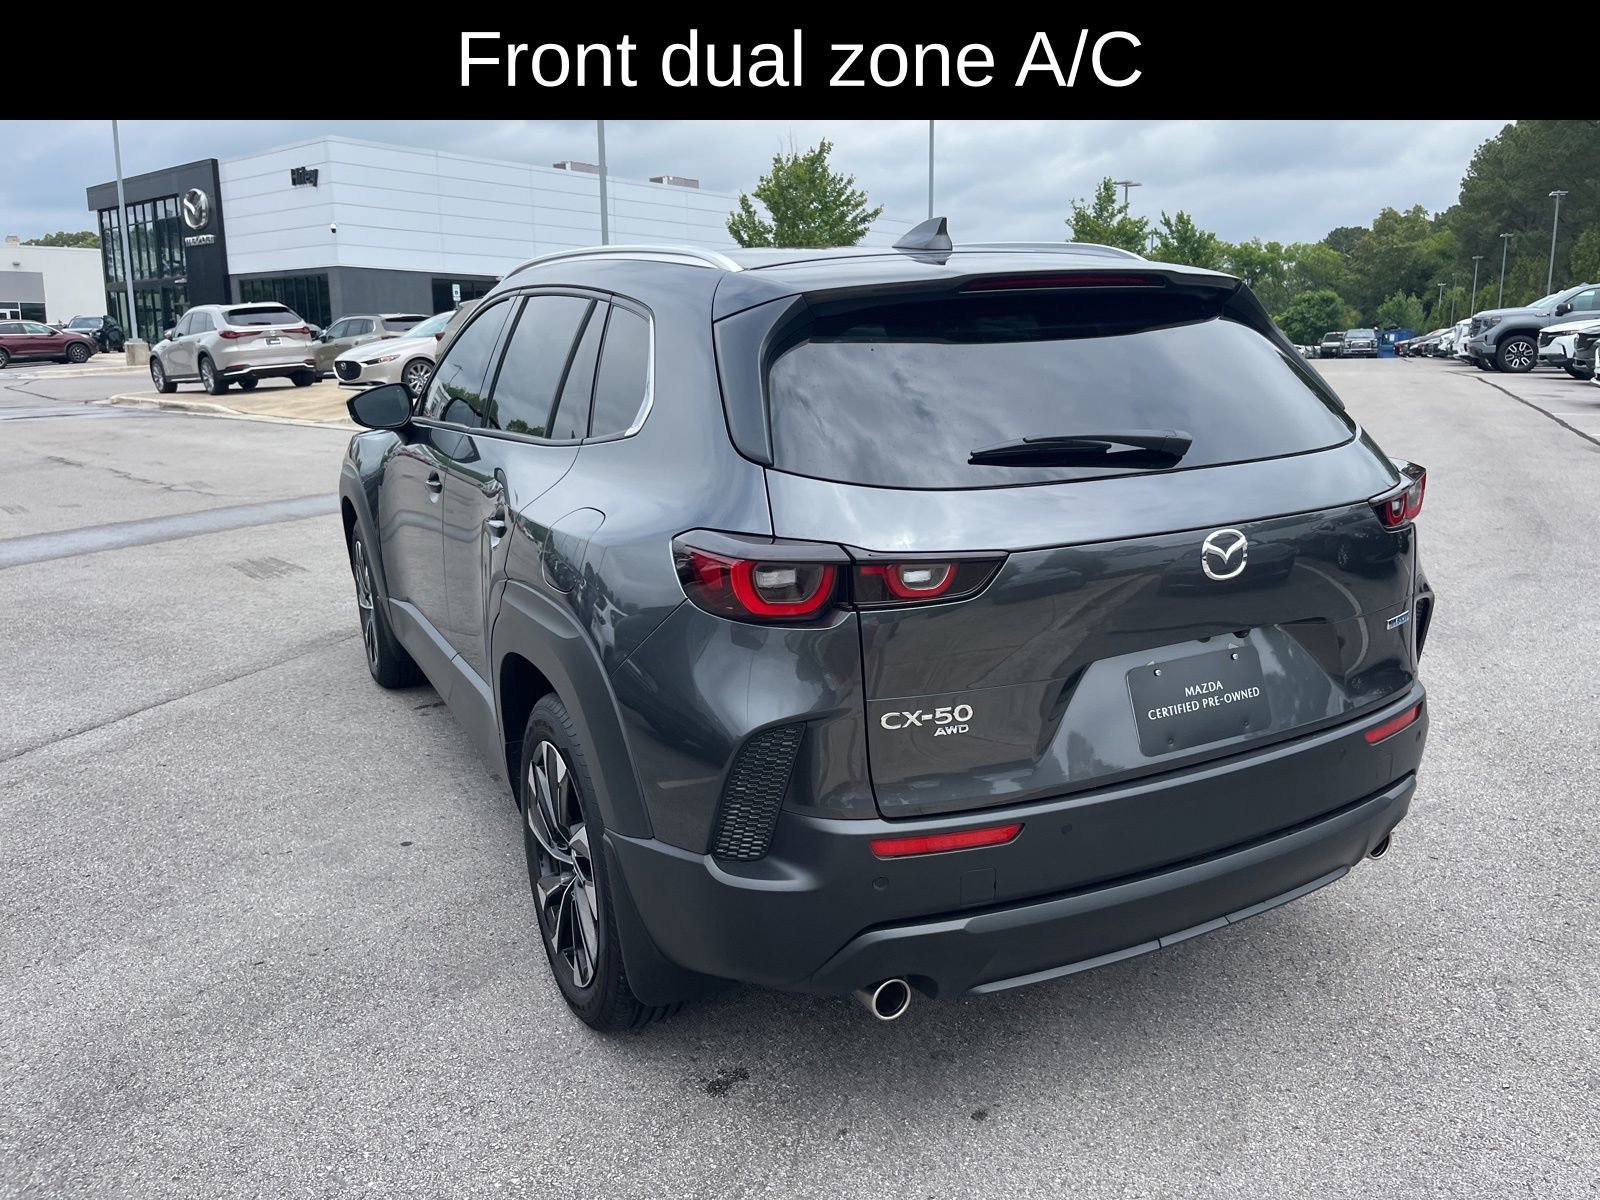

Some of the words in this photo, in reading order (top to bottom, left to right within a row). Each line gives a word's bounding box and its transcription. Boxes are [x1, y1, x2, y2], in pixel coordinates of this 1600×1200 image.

[1185, 680, 1224, 698] MAZDA
[1147, 700, 1200, 721] CERTIFIED
[1202, 686, 1260, 709] PRE-OWNED
[880, 704, 974, 730] CX-50
[933, 724, 970, 737] AWD
